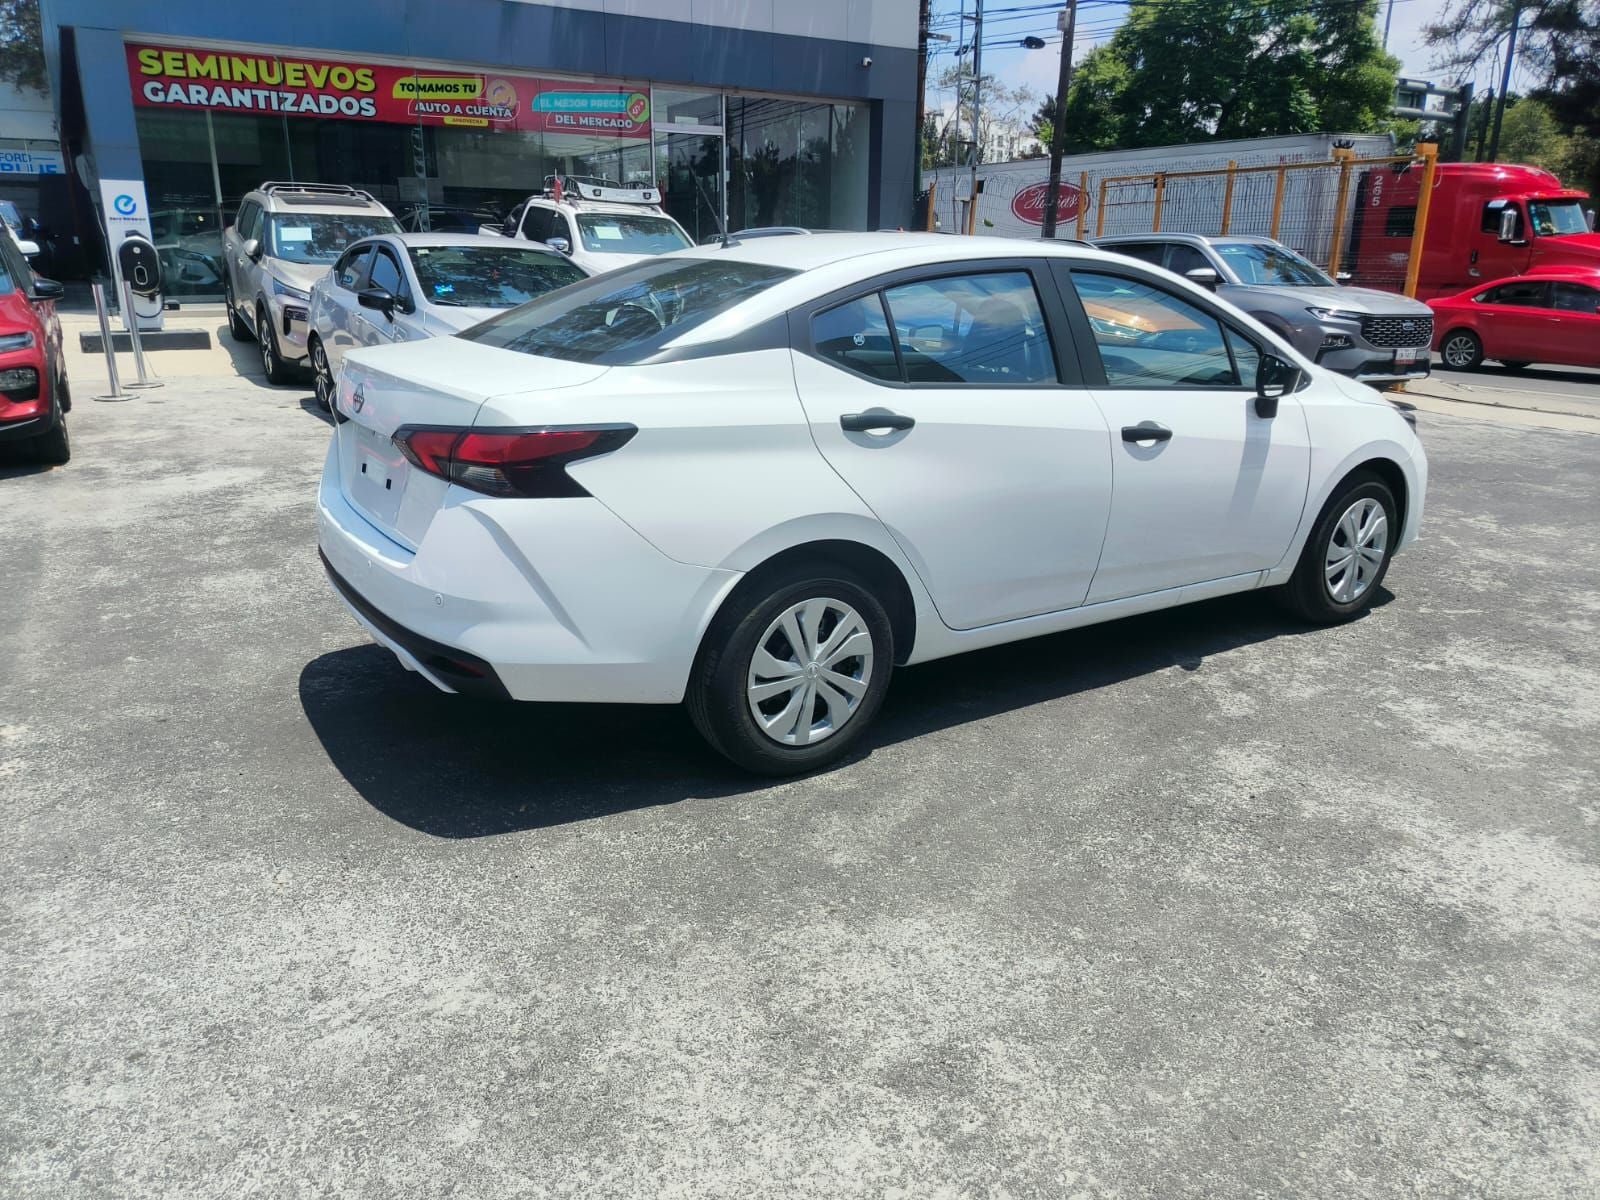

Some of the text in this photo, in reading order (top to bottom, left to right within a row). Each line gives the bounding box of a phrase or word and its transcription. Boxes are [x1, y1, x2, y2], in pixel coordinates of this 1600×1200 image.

[138, 48, 377, 93] SEMINUEVOS
[400, 82, 477, 93] TOMAMOS TU
[143, 80, 377, 118] GARANTIZADOS
[540, 98, 626, 109] EL MEJOR PRECIO
[415, 101, 513, 118] AUTO A CUENTA
[555, 114, 633, 129] DEL MERCADO
[1372, 175, 1384, 206] 265
